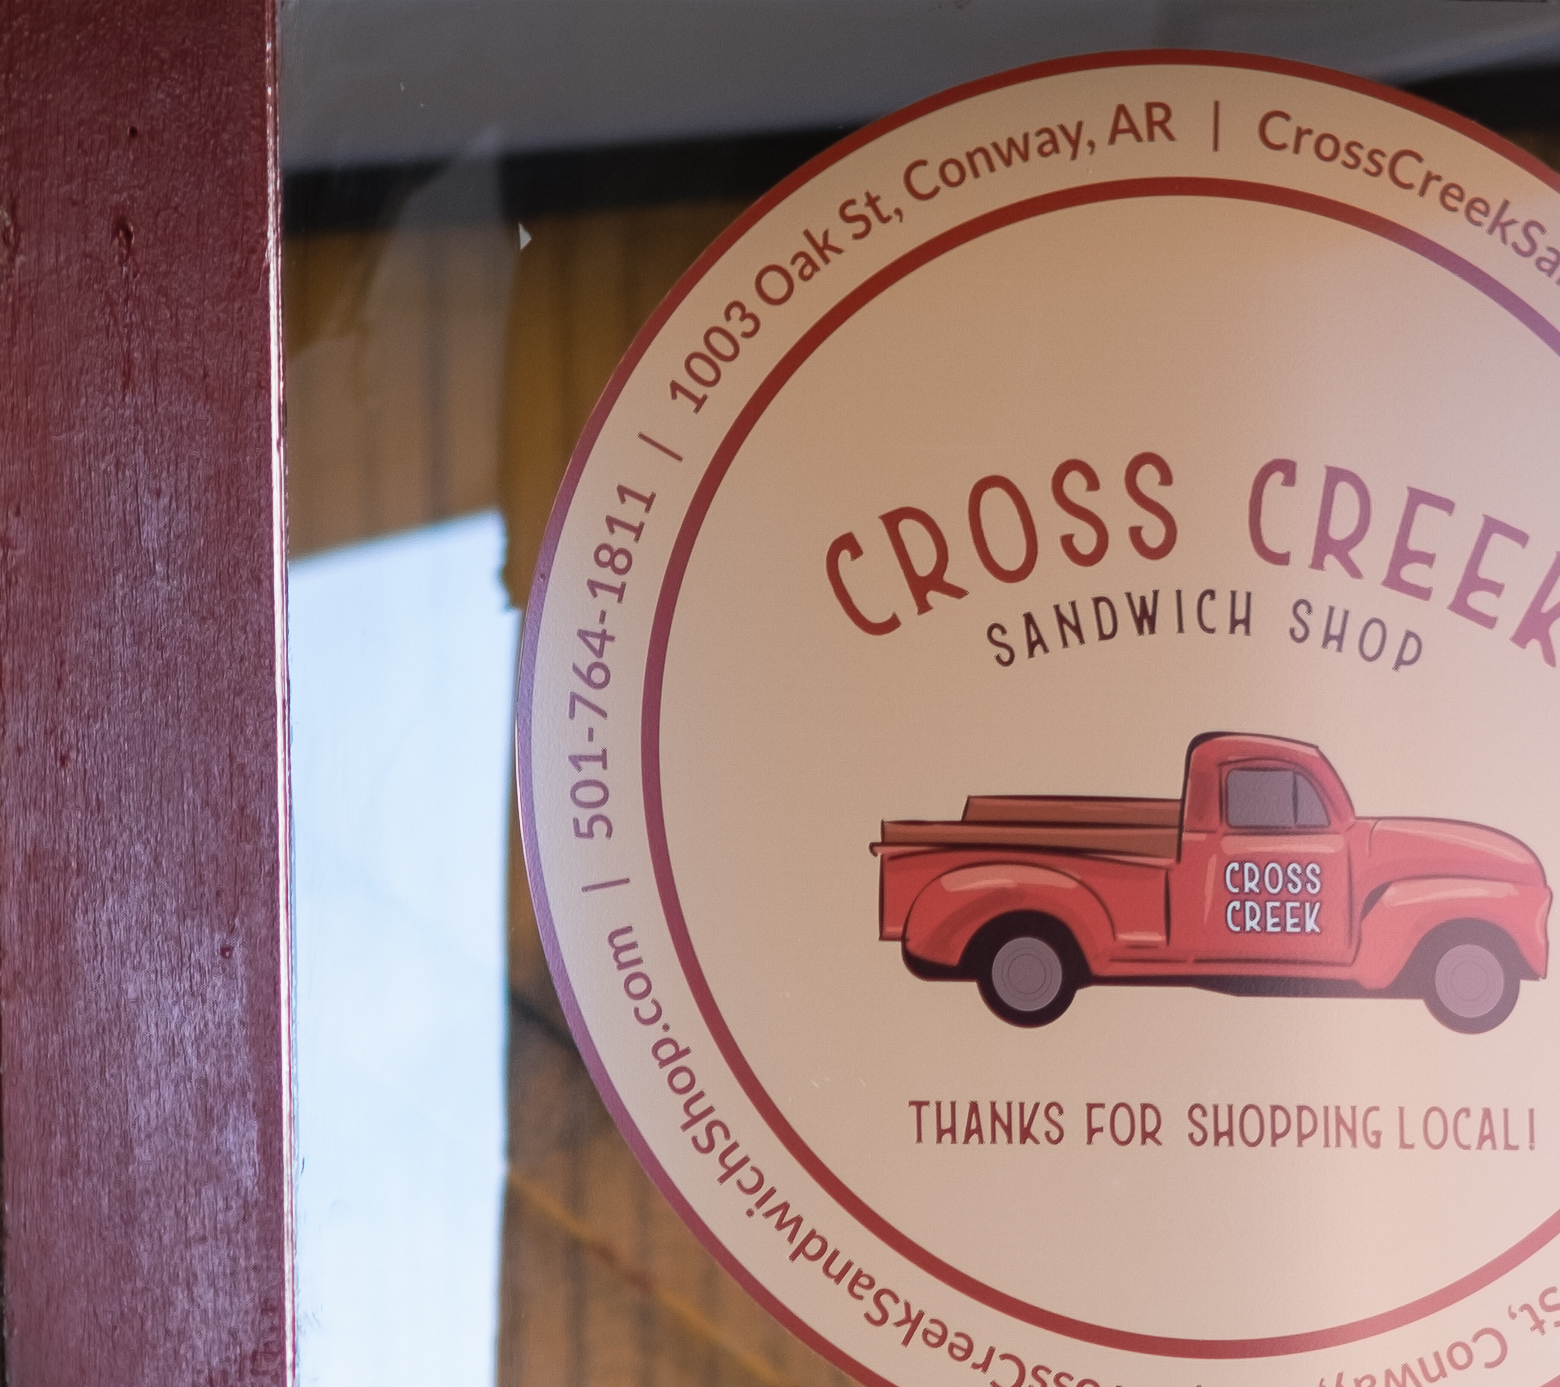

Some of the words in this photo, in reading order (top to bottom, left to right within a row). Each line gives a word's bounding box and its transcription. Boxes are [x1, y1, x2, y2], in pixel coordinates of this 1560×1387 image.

[568, 483, 656, 841] 501-764-1811
[668, 300, 761, 414] 1003
[754, 227, 845, 306] Oak
[838, 190, 904, 241] St,
[902, 119, 1096, 202] Conway,
[1107, 101, 1175, 145] AR
[826, 452, 1178, 636] CROSS
[986, 589, 1252, 667] SANDWICH
[1289, 598, 1423, 672] SHOP
[1225, 862, 1322, 894] CROSS
[1225, 901, 1322, 934] CREEK
[908, 1100, 1065, 1146] THANKS
[1085, 1102, 1163, 1147] FOR
[1188, 1103, 1382, 1149] SHOPPING
[1398, 1107, 1536, 1151] LOCAL!
